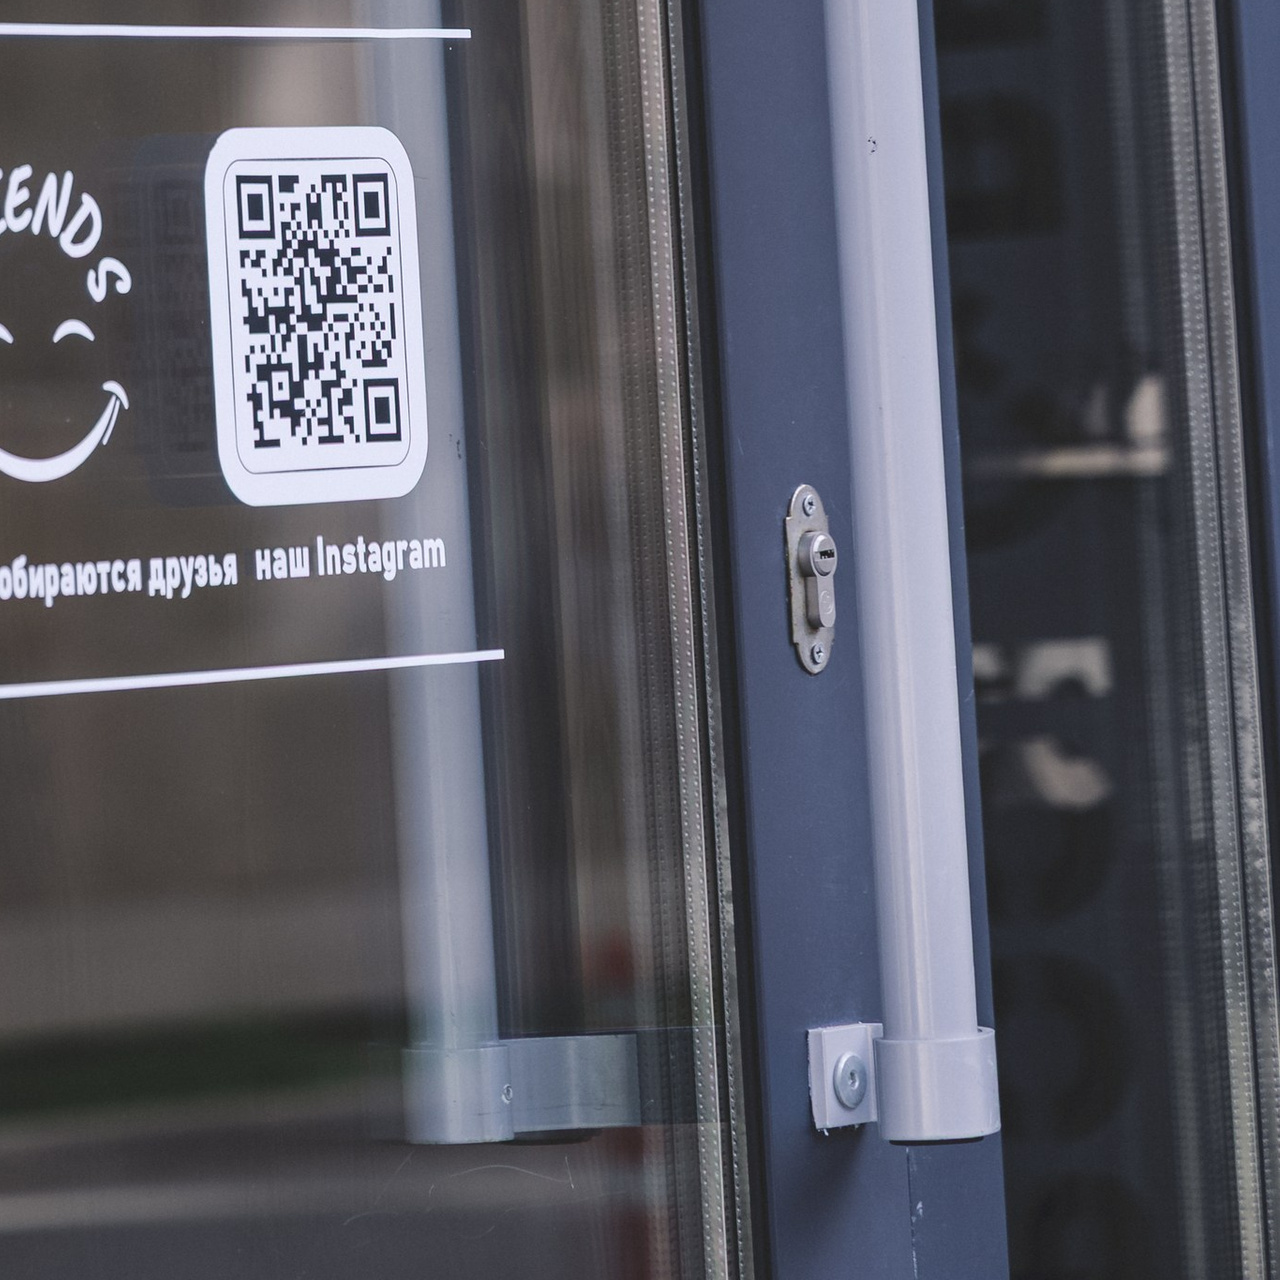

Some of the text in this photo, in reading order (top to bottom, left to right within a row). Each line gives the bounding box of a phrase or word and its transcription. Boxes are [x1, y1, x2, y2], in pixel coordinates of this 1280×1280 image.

[148, 553, 238, 600] друзья
[255, 535, 447, 582] наш Instagram
